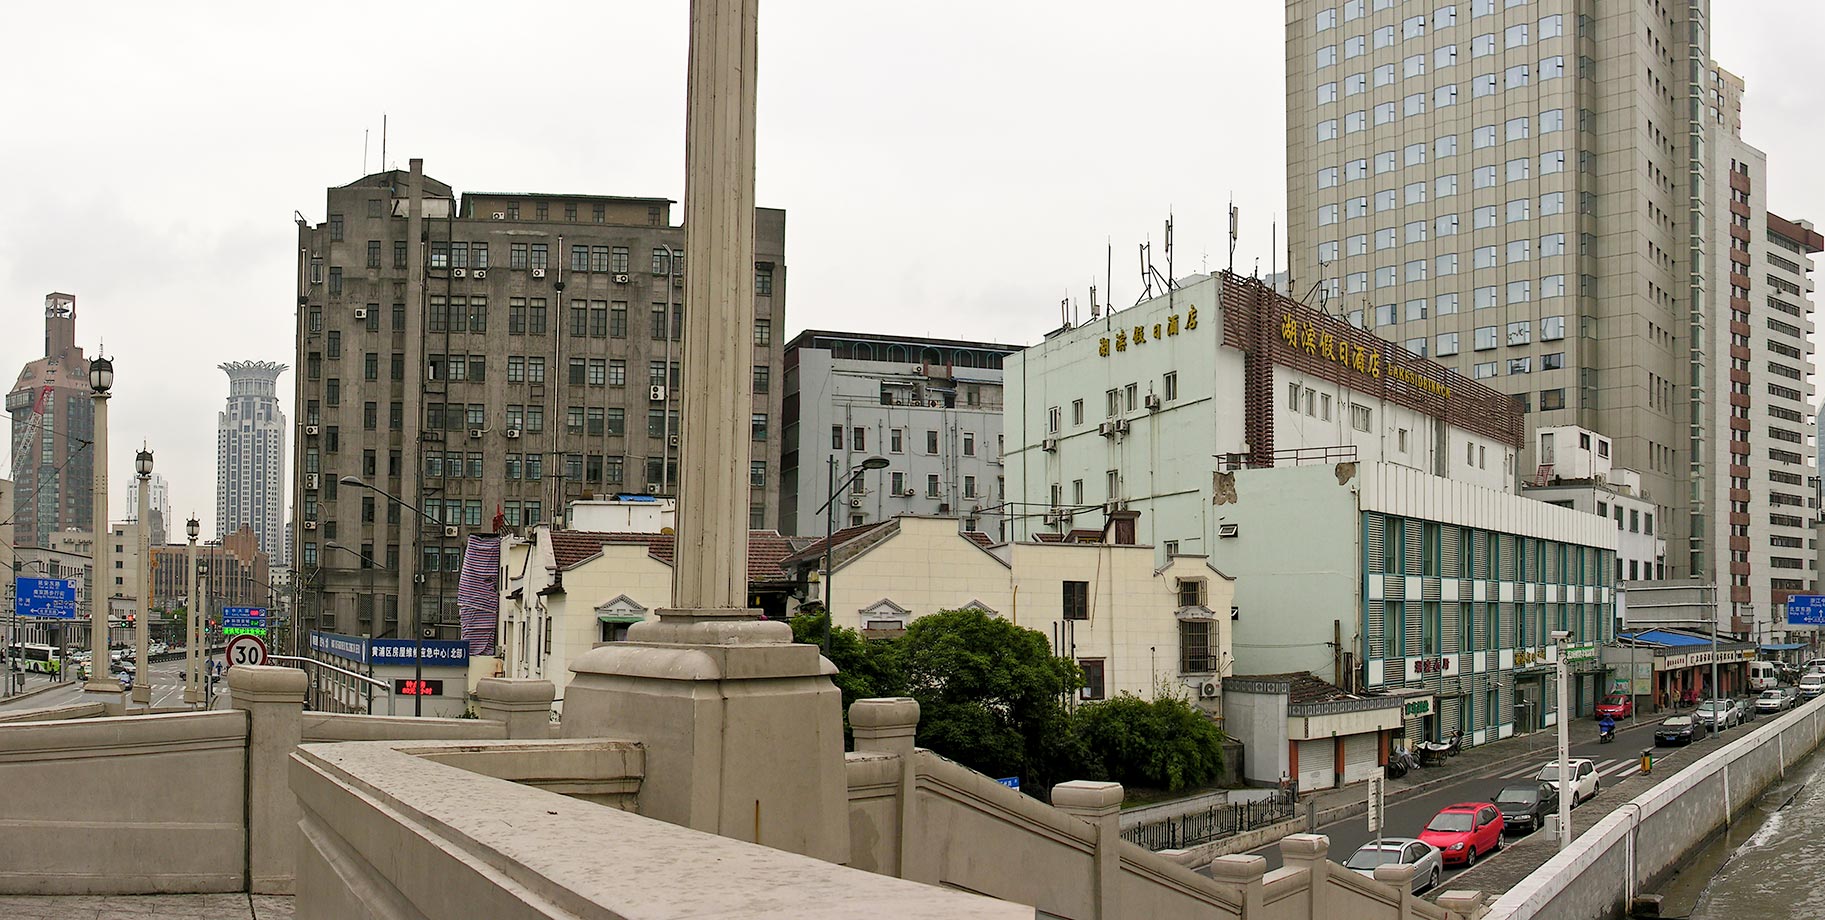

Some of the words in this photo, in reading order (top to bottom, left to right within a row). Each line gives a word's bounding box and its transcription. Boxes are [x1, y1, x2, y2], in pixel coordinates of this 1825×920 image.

[1099, 304, 1198, 358] 湖滨假日酒店
[1281, 313, 1381, 379] 湖滨假日酒店
[236, 646, 258, 664] 30
